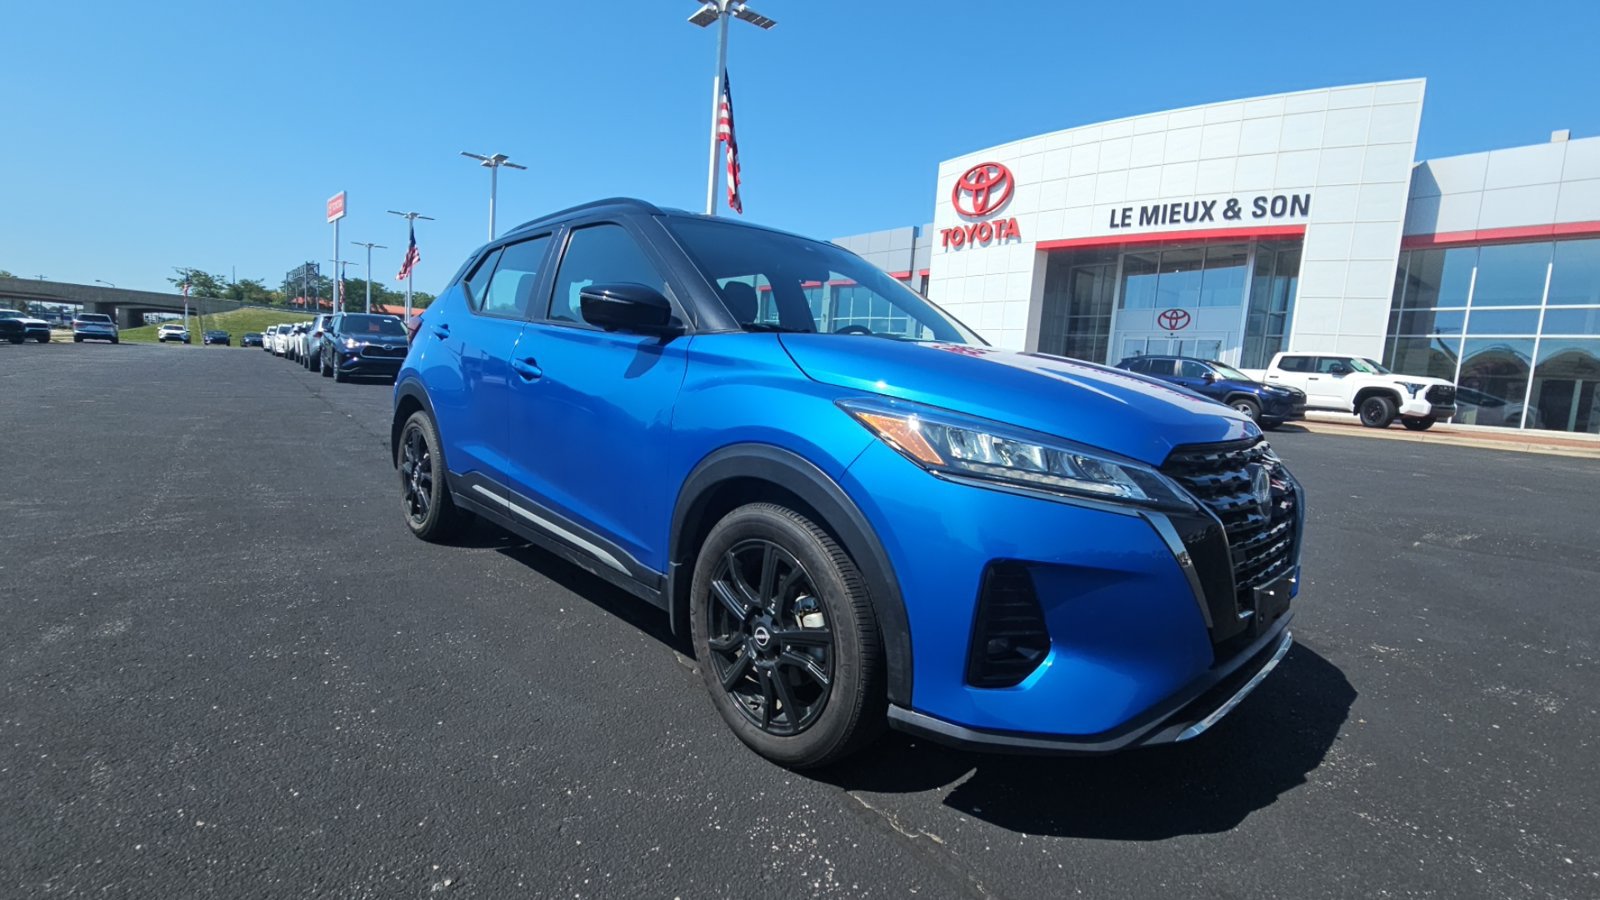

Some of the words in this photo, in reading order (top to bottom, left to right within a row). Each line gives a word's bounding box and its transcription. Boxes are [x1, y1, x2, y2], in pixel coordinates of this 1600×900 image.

[1109, 207, 1133, 228] LE
[1138, 200, 1217, 227] MIEUX
[1222, 198, 1242, 221] &
[1252, 193, 1311, 219] SON
[940, 217, 1020, 248] TOYOTA
